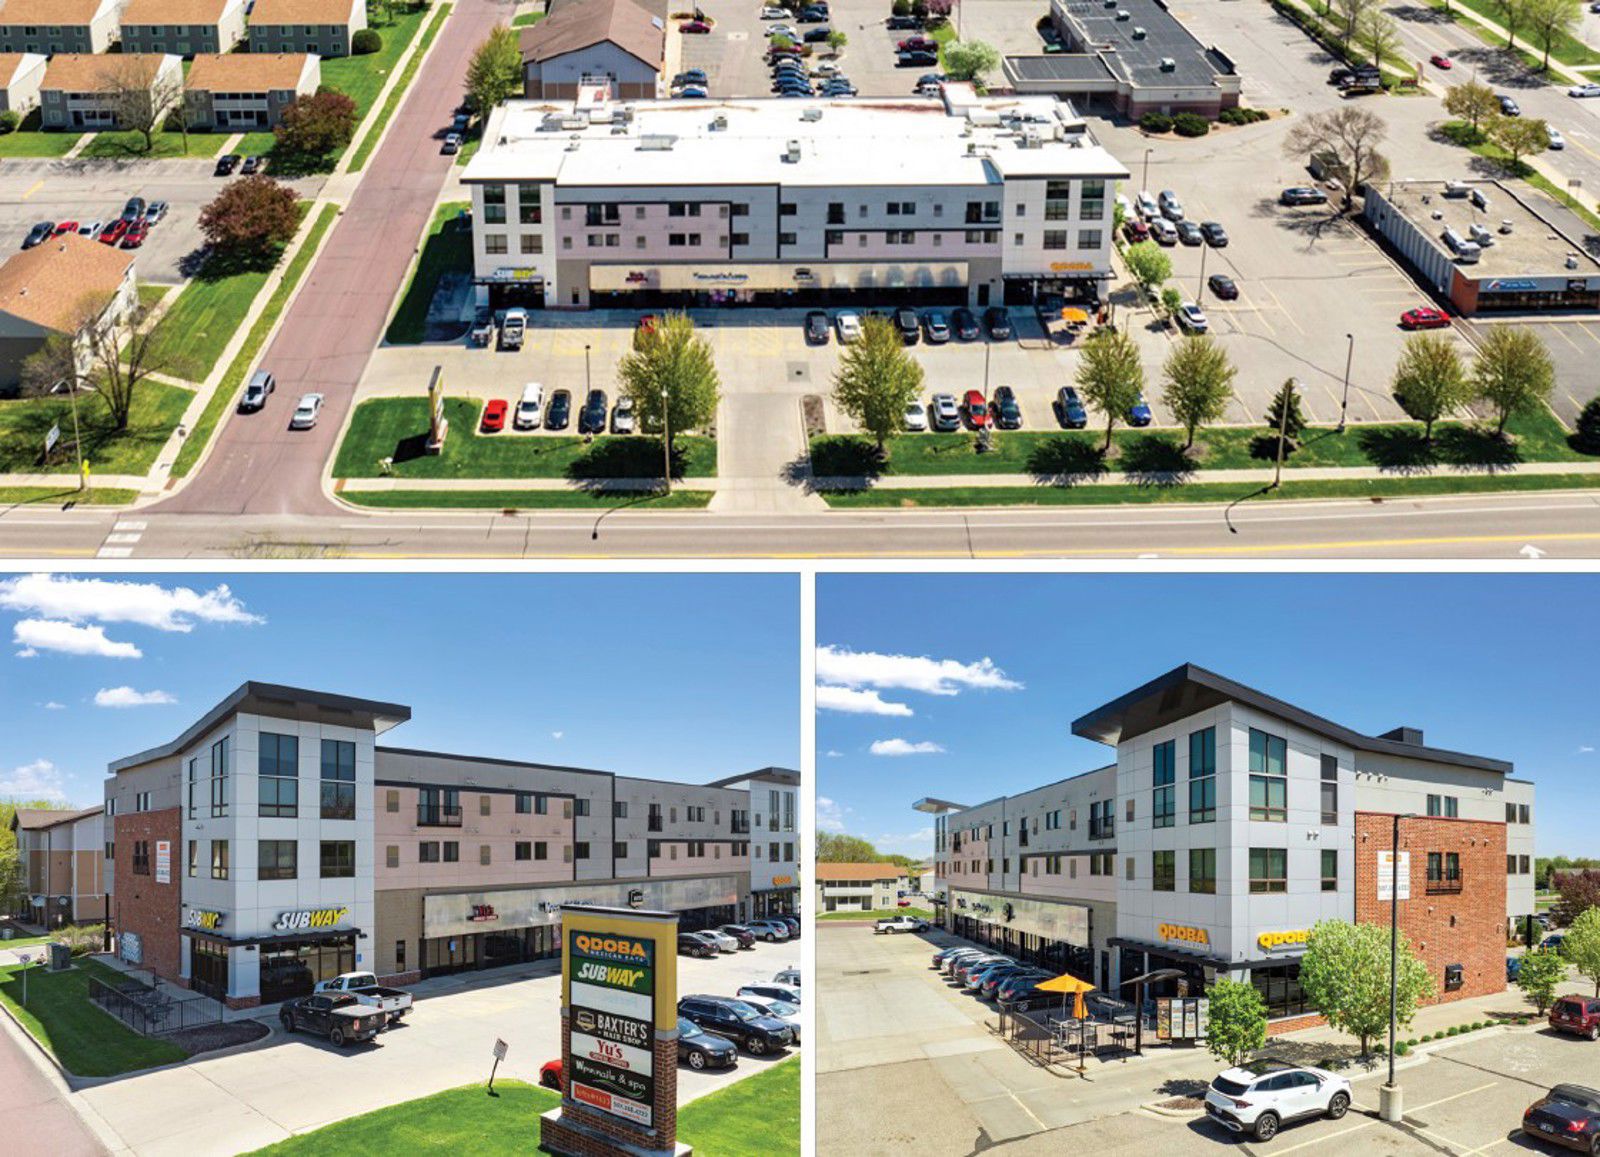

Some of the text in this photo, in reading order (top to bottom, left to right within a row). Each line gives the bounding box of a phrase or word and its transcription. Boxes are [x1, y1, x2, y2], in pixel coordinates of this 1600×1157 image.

[276, 908, 348, 929] SUBWAY
[1158, 923, 1208, 945] QDOBA
[1259, 931, 1309, 949] QDOB
[576, 935, 646, 957] QDOBA
[578, 962, 644, 987] SUBWAY
[597, 1014, 647, 1039] BAXTER'S
[597, 1040, 623, 1058] Yu's
[628, 1080, 646, 1092] spa
